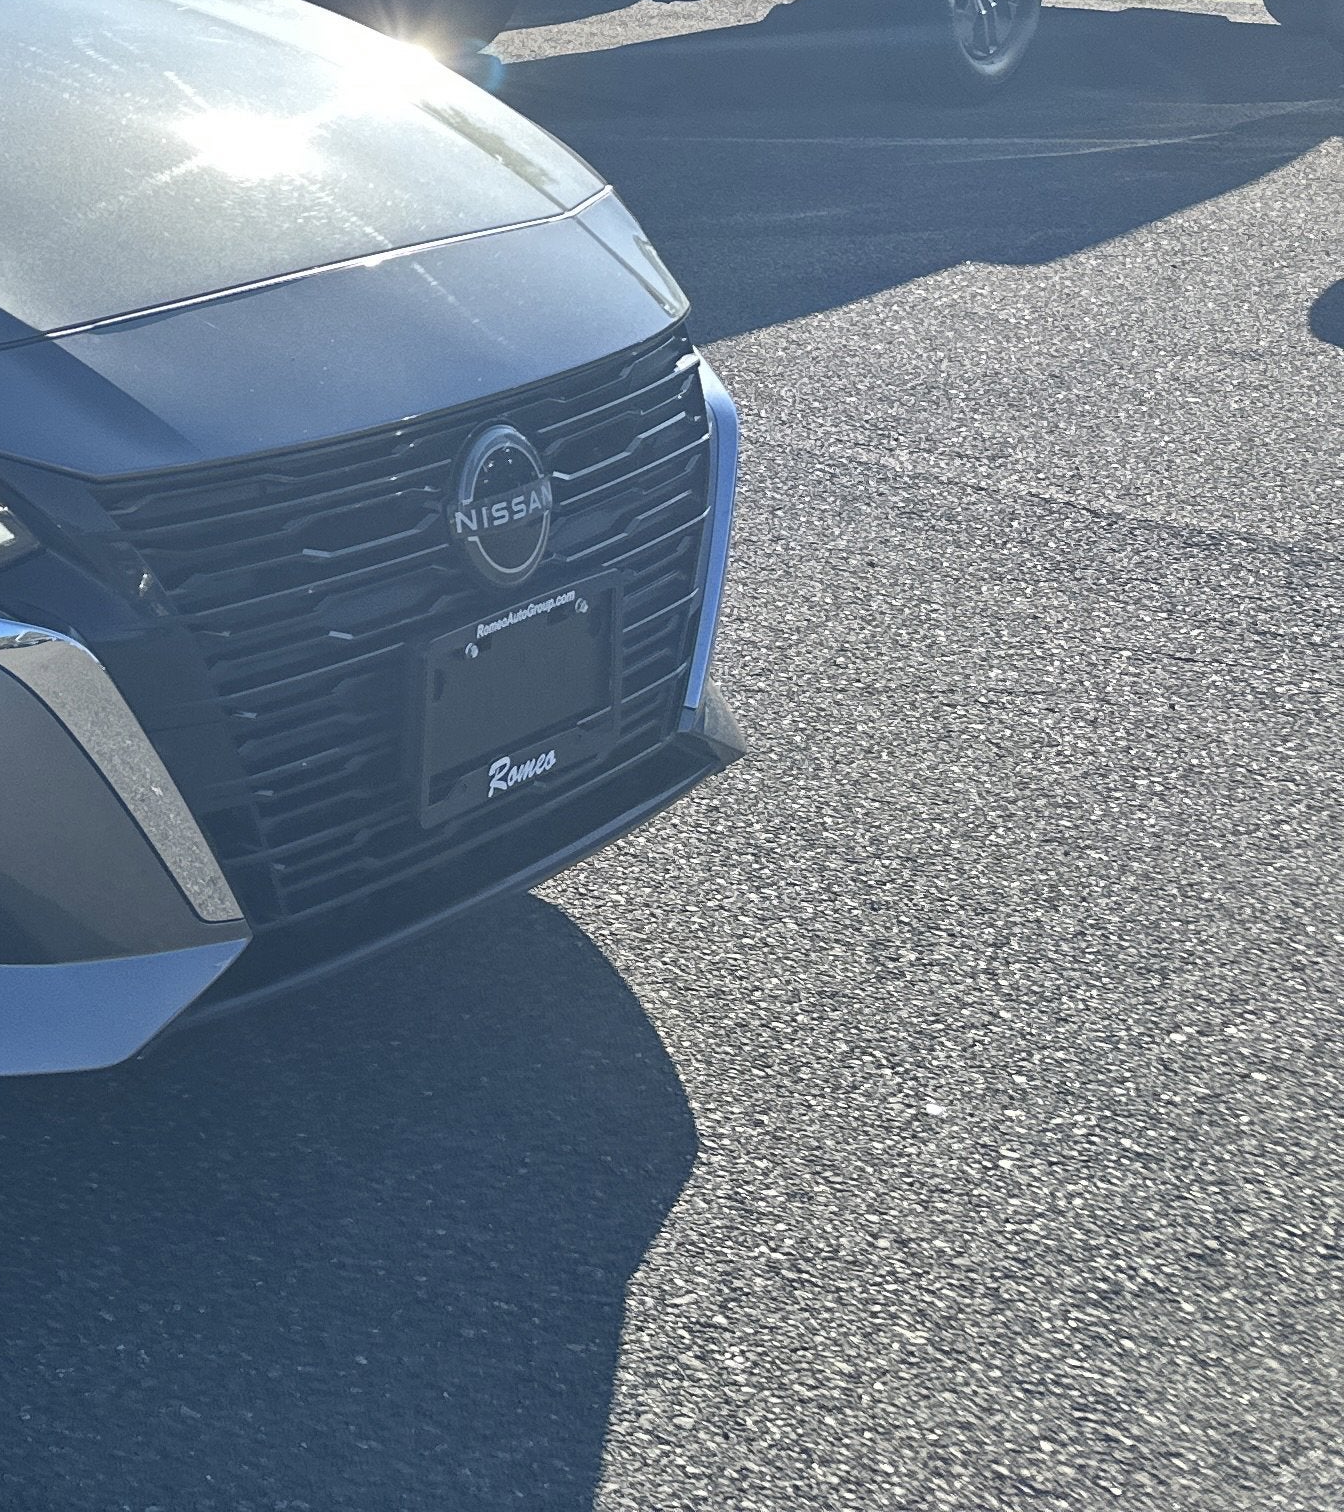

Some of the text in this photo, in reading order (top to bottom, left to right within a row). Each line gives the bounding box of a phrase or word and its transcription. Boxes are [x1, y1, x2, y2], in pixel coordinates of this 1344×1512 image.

[454, 480, 553, 534] NISSAN
[476, 590, 576, 639] RomeoAutoGroup.com
[486, 748, 557, 798] Romeo
